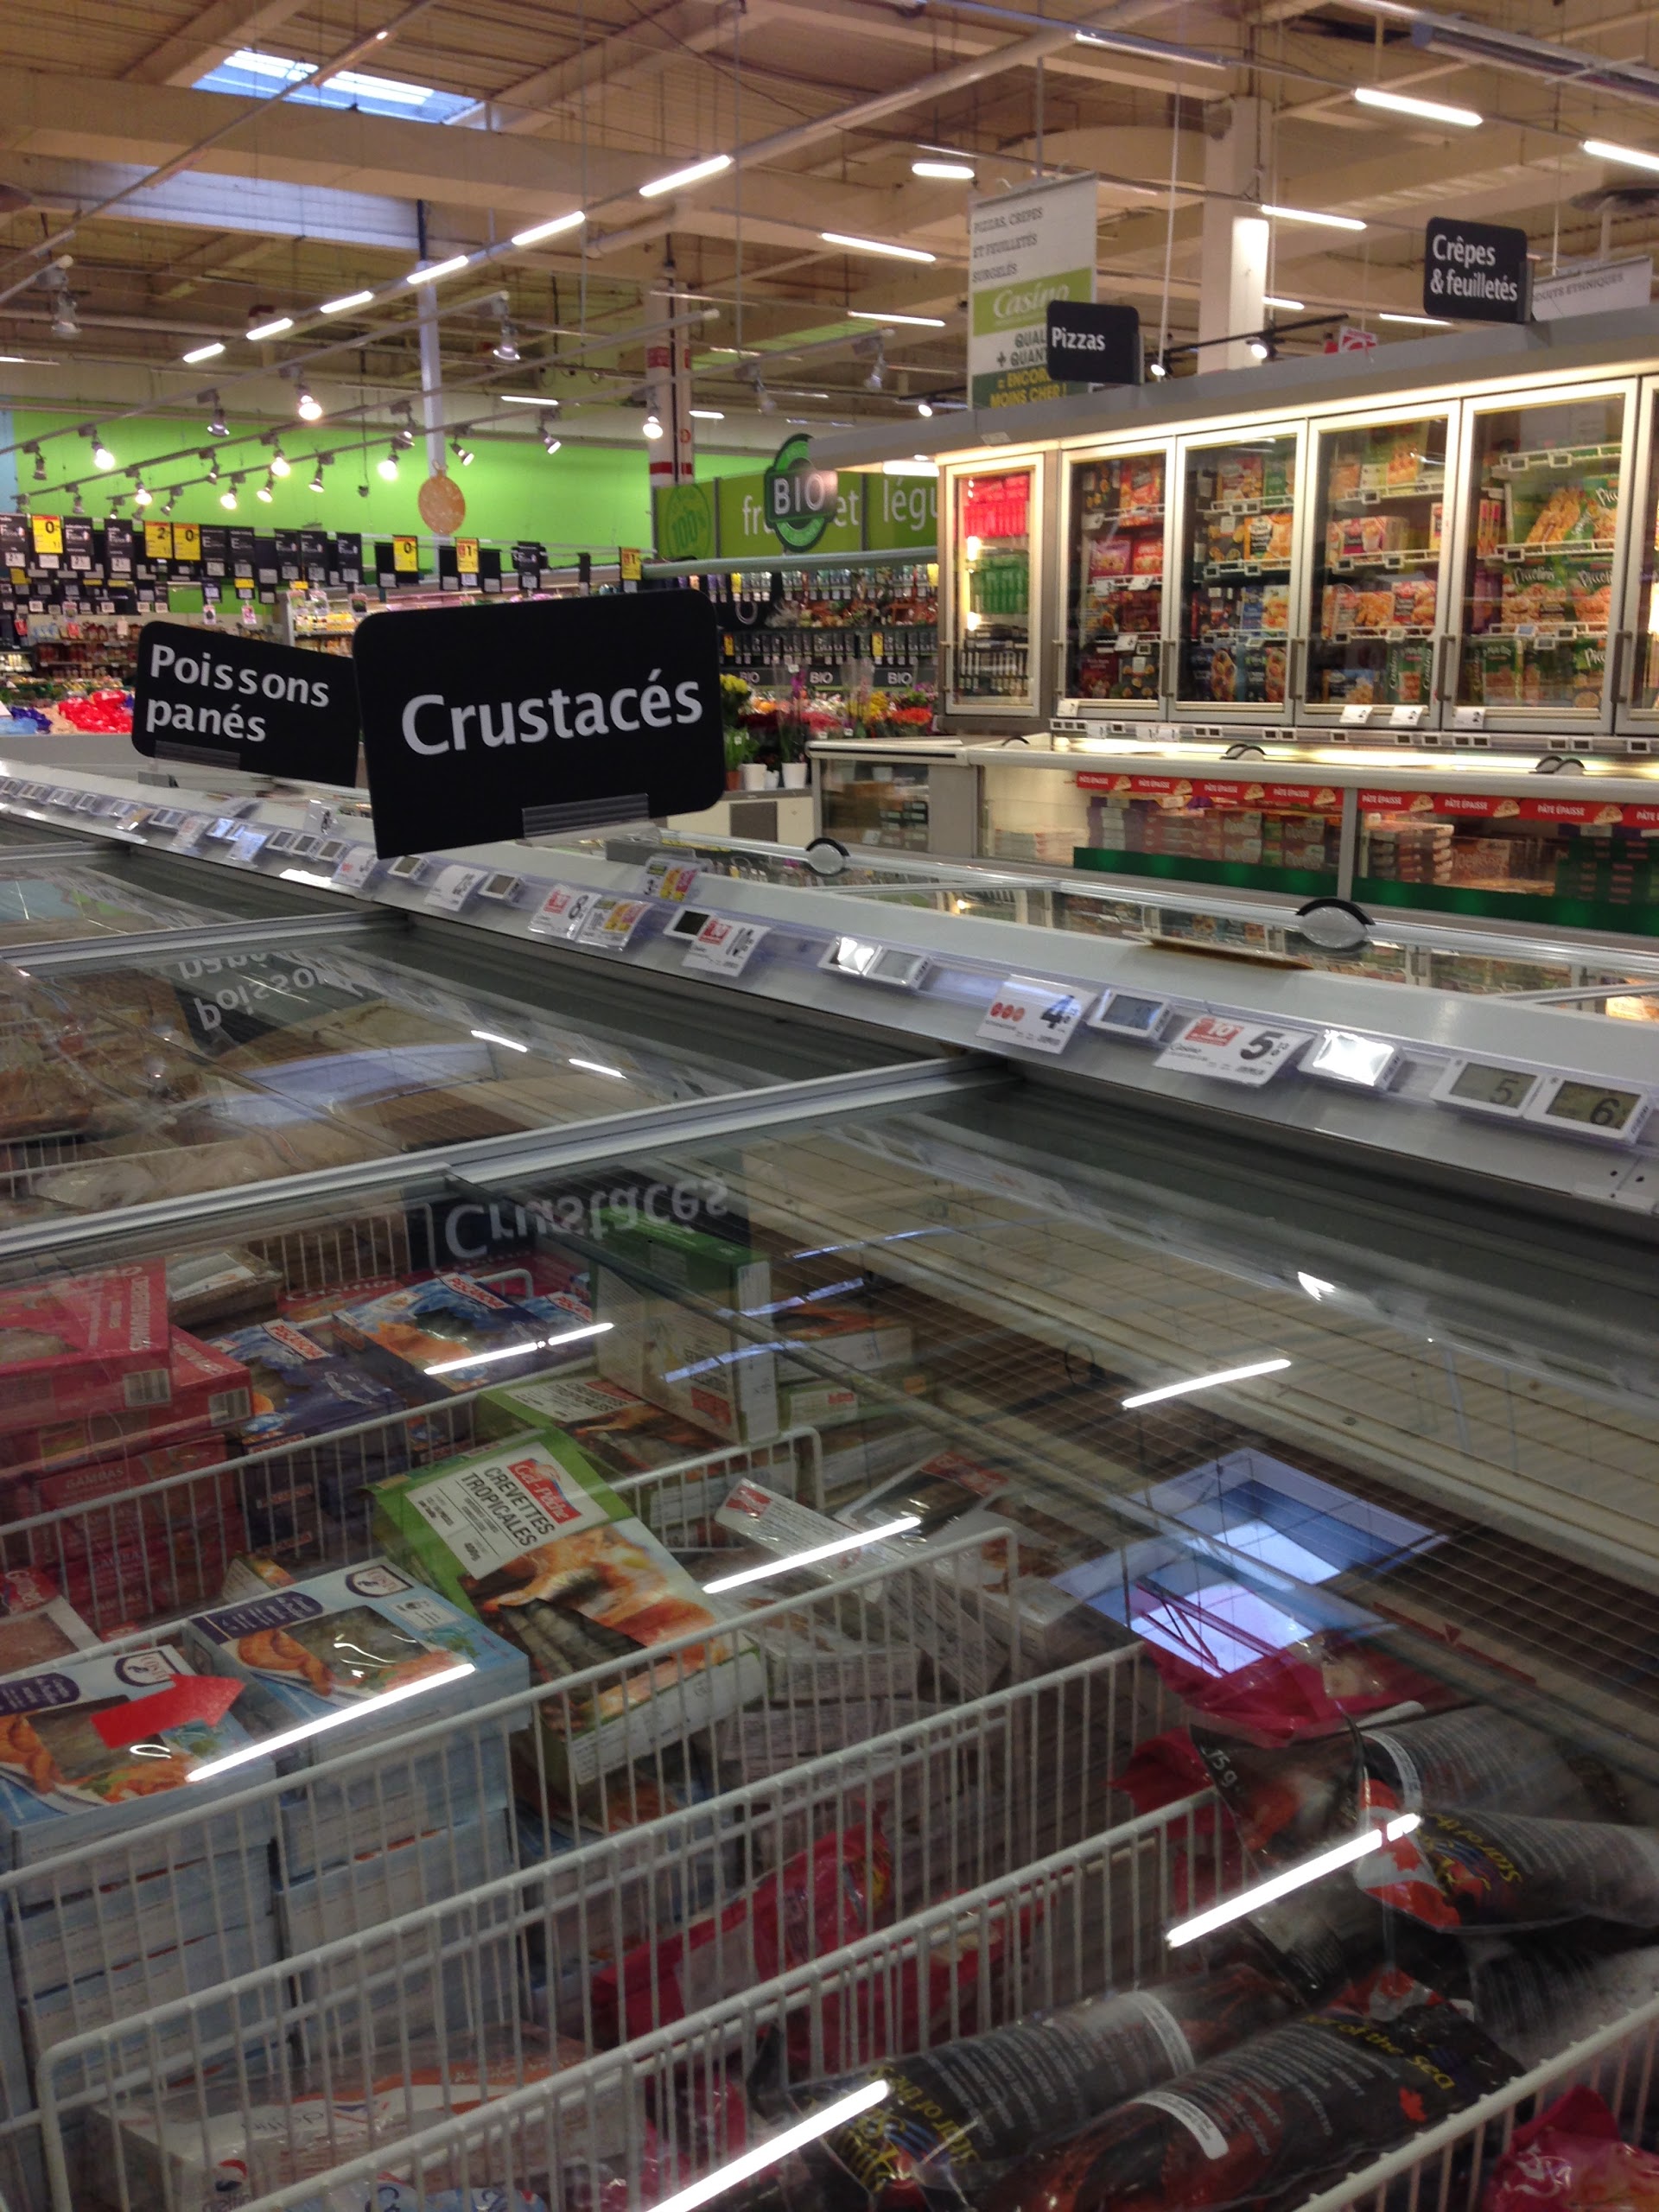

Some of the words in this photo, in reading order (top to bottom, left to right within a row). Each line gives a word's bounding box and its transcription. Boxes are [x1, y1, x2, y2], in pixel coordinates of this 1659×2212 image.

[1432, 233, 1496, 270] Crêpes
[1430, 268, 1444, 295] &
[1446, 267, 1518, 302] feuilletés
[1052, 327, 1106, 352] Pizzas
[774, 474, 824, 514] BIO
[149, 644, 330, 708] Poissons
[810, 673, 834, 684] BIO
[887, 672, 912, 684] BIO
[146, 697, 267, 742] panés
[402, 668, 702, 756] Crustacés
[1445, 798, 1460, 808] PÂTE
[1461, 798, 1488, 810] ÉPAISSE
[1537, 804, 1554, 815] PÂTE
[1556, 804, 1585, 817] ÉPAISSE
[1637, 810, 1654, 822] PÂTE
[1040, 995, 1076, 1029] 4
[1240, 1031, 1286, 1060] 5
[1490, 1078, 1519, 1105] 5
[1590, 1097, 1620, 1126] 6
[461, 1471, 537, 1547] TROPICALES
[484, 1466, 556, 1535] CREVETTES
